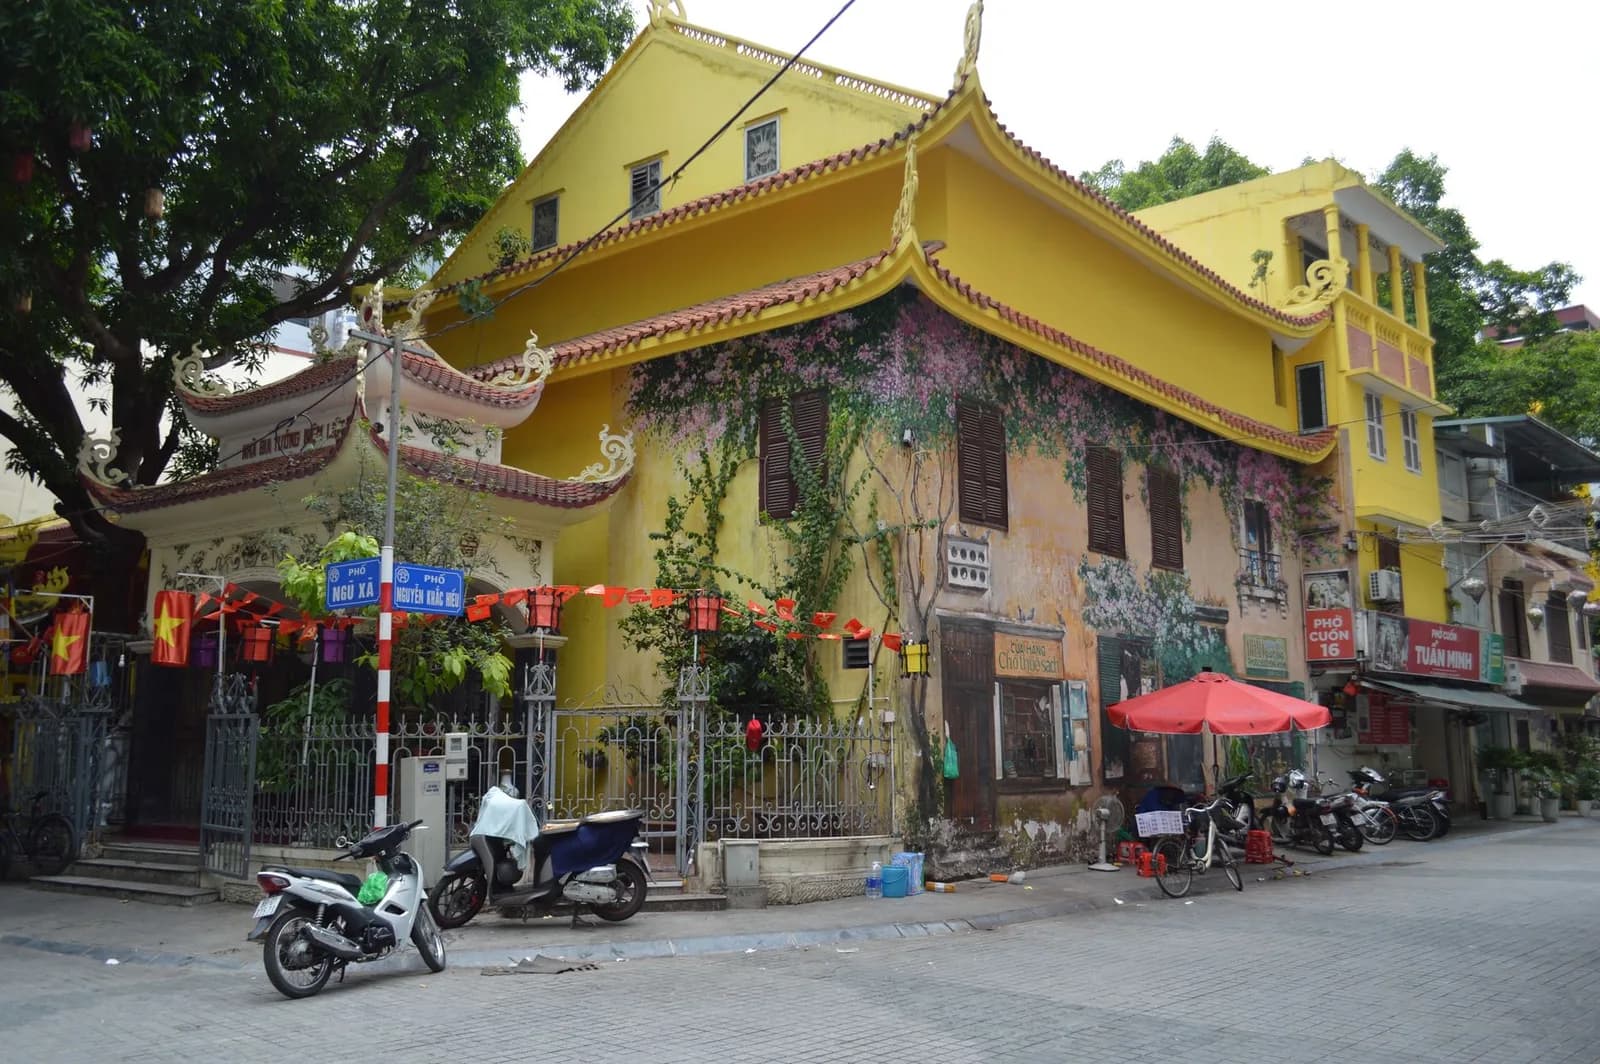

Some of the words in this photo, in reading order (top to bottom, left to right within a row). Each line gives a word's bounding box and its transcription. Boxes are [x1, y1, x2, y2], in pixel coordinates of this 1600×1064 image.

[348, 563, 366, 576] PHỐ
[424, 573, 446, 584] PHỐ
[333, 580, 354, 602] NGŨ
[358, 576, 374, 599] XÃ
[396, 583, 423, 604] NGUYỄN
[427, 585, 444, 606] KHẮC
[445, 588, 459, 608] HIẾU
[1313, 614, 1343, 629] PHỞ
[1309, 627, 1349, 642] CUỐN
[1320, 643, 1341, 657] 16
[1447, 649, 1472, 670] MINH
